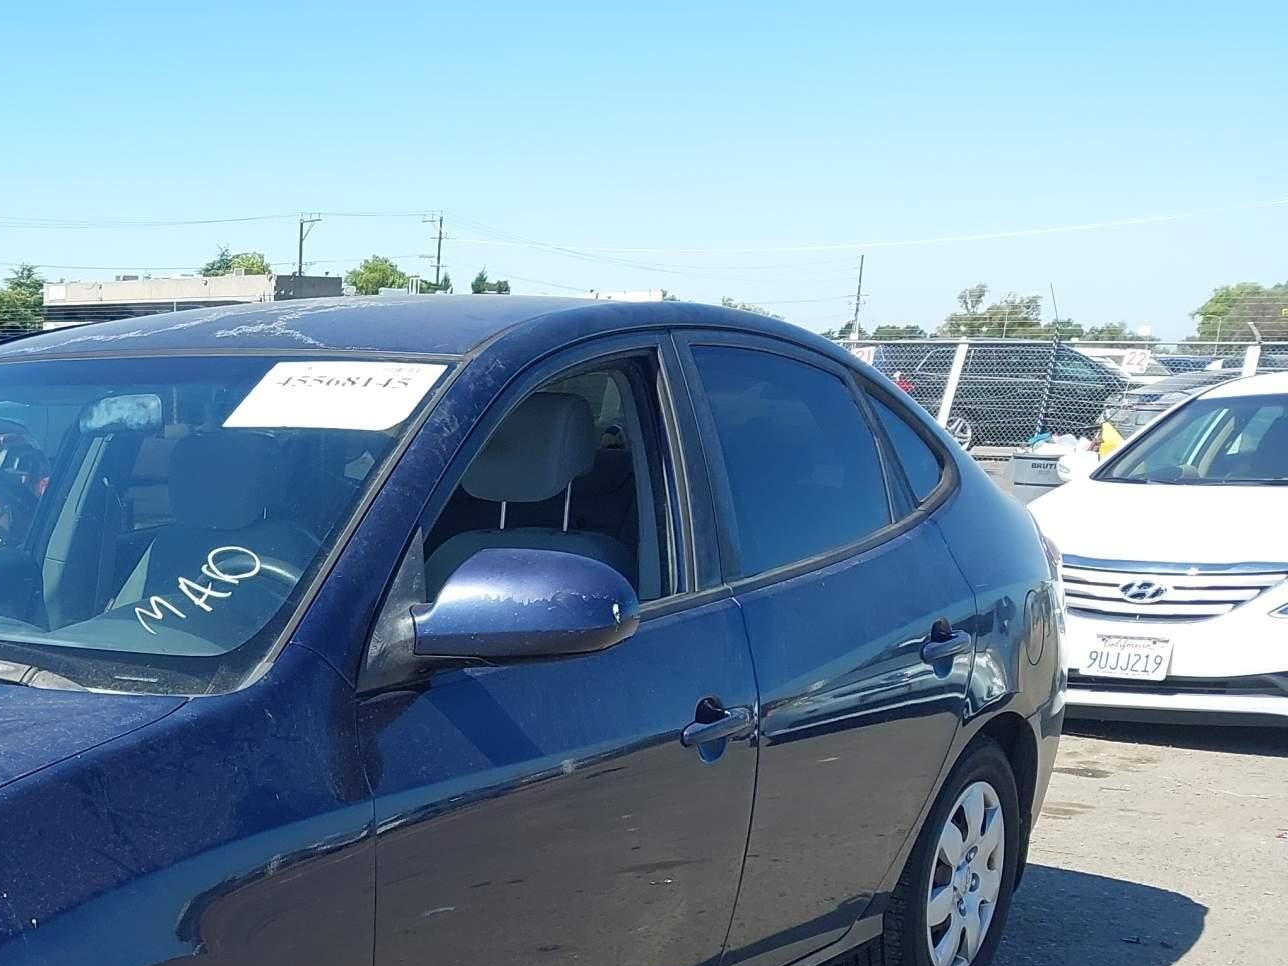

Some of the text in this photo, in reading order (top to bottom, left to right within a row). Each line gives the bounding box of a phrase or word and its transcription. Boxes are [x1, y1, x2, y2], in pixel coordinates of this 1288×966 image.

[1125, 351, 1147, 366] 22
[276, 375, 413, 389] 45568145
[1086, 650, 1164, 674] 9UJJ219
